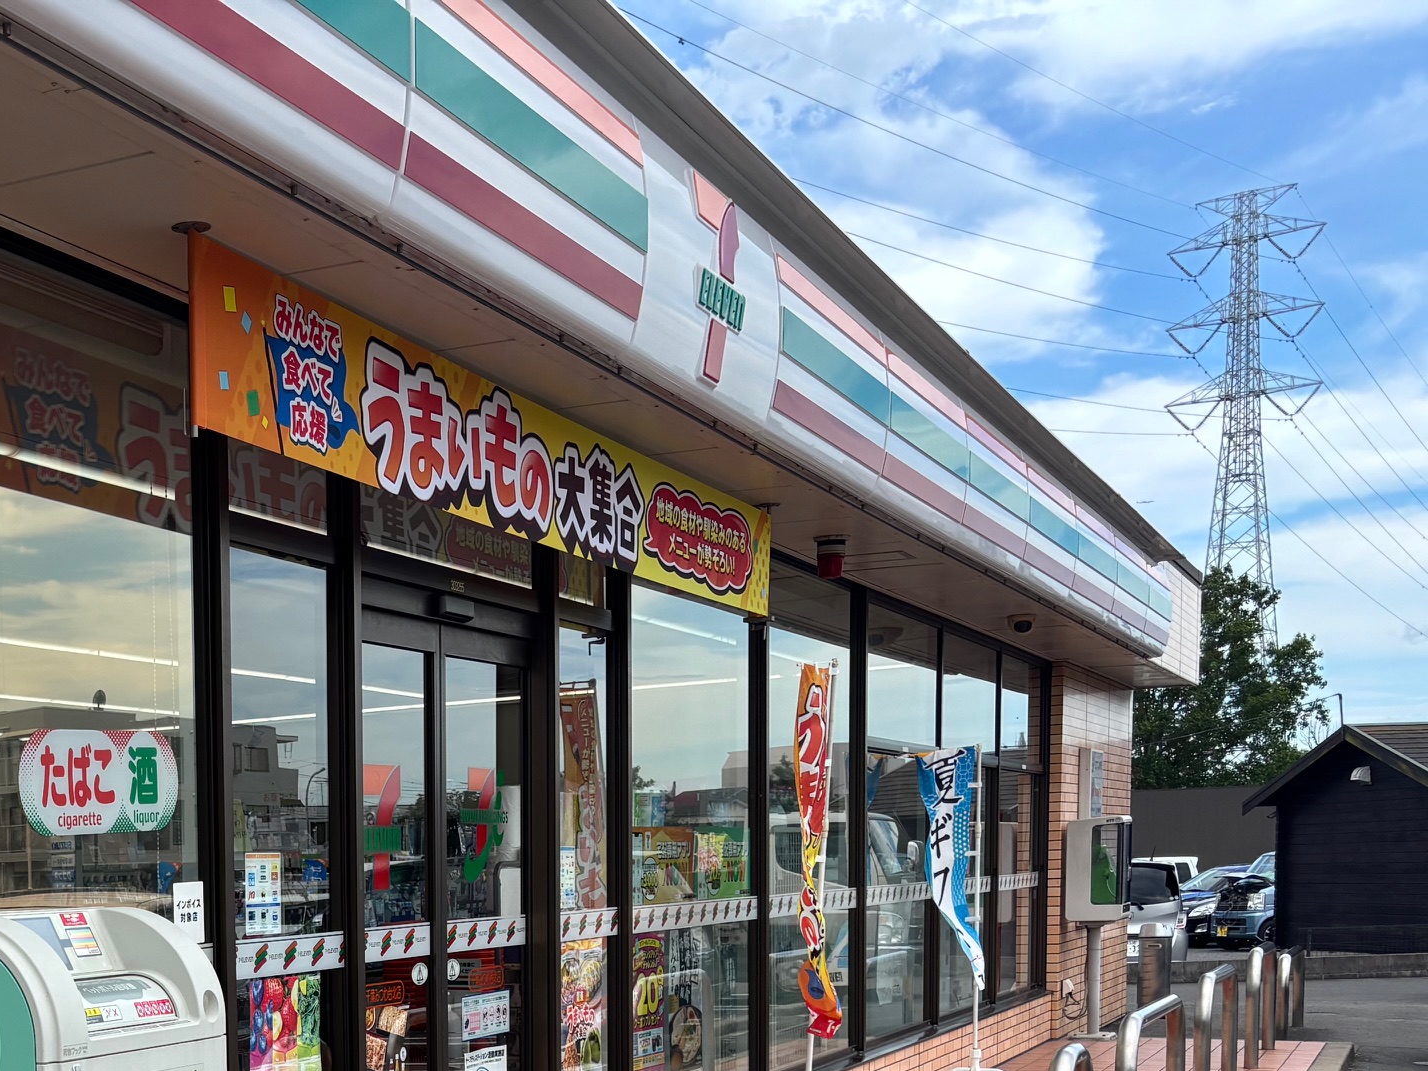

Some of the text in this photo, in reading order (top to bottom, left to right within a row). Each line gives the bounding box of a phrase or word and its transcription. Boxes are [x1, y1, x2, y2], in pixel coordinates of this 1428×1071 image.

[274, 295, 342, 363] みんなで
[284, 350, 334, 401] 食べて
[291, 399, 328, 446] 応援
[362, 352, 642, 552] うまいもの大集合
[656, 496, 747, 554] 地域の食材や馴染みのある
[40, 743, 159, 808] たばこ 酒
[58, 809, 160, 830] cigarette liquor
[176, 897, 201, 909] インボイス
[180, 911, 198, 922] 対象店
